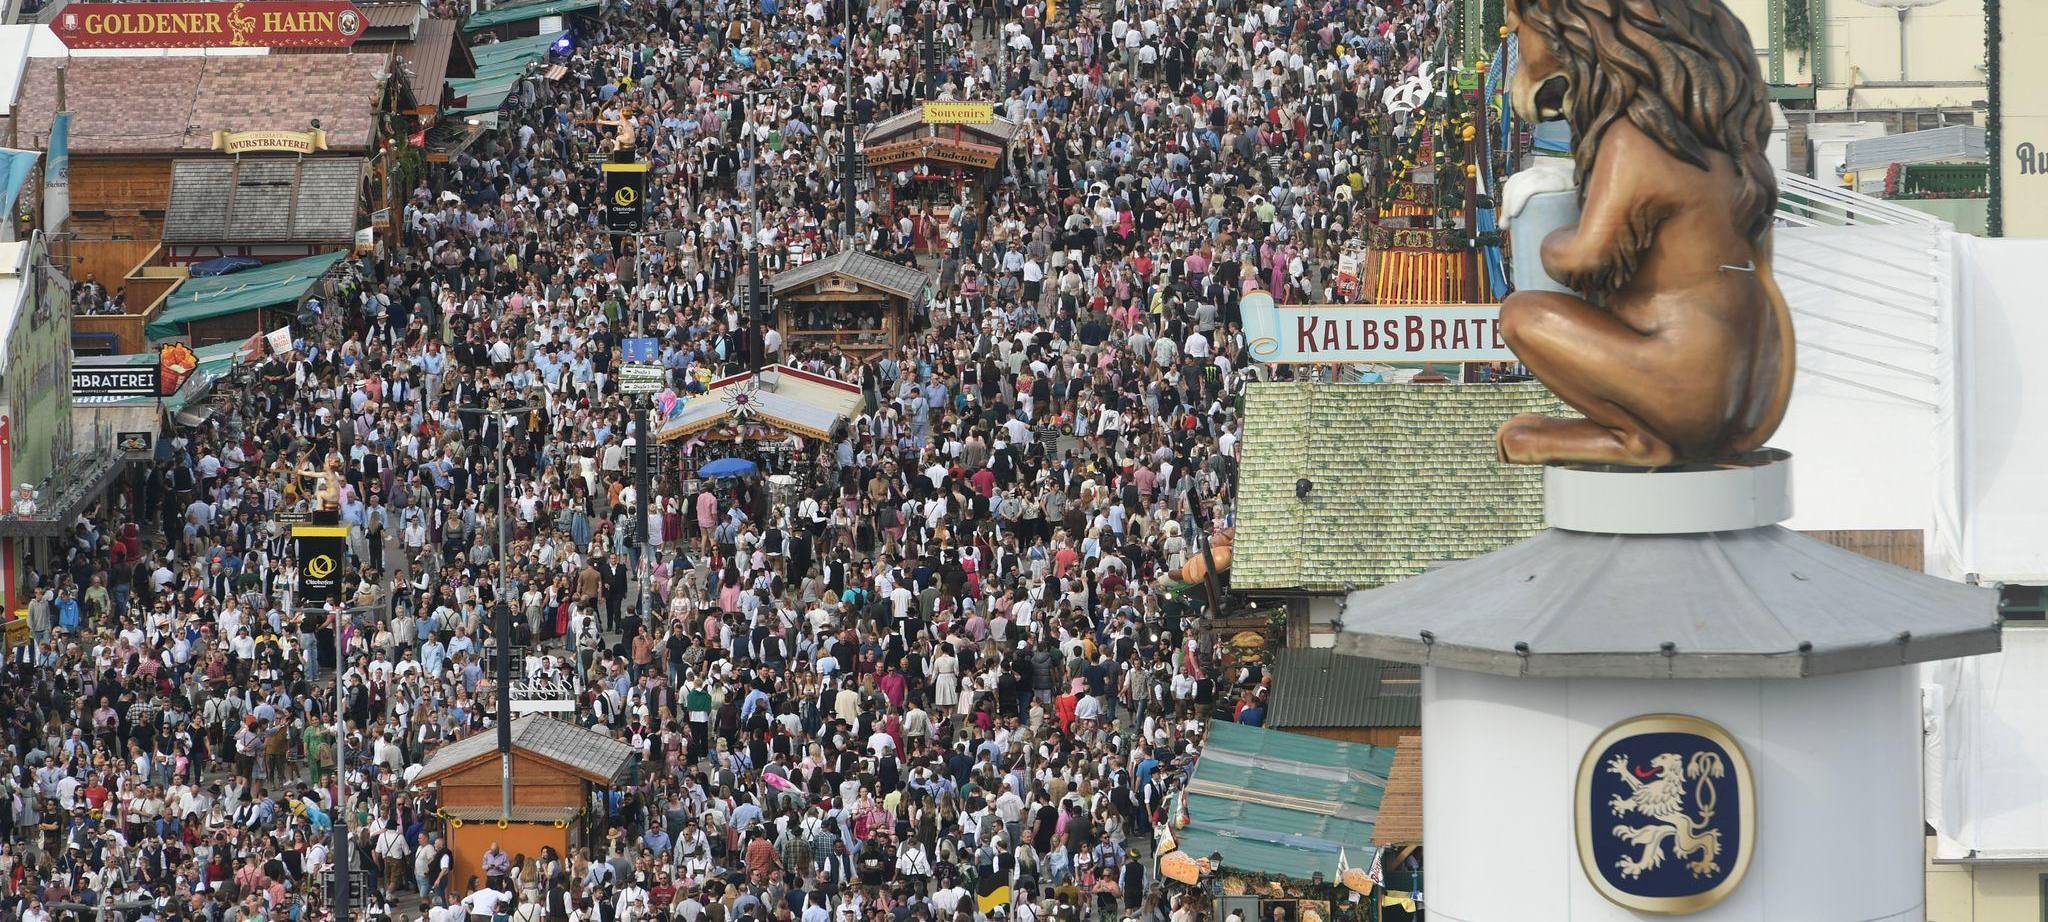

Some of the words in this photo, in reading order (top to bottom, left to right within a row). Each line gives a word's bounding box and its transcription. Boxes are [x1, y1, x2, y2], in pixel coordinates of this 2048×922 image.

[85, 13, 223, 34] GOLDENER
[262, 11, 334, 33] HAHN
[930, 108, 985, 118] Souvenirs
[229, 138, 310, 150] WURSTBRATEREI
[72, 374, 154, 387] HBRATEREI
